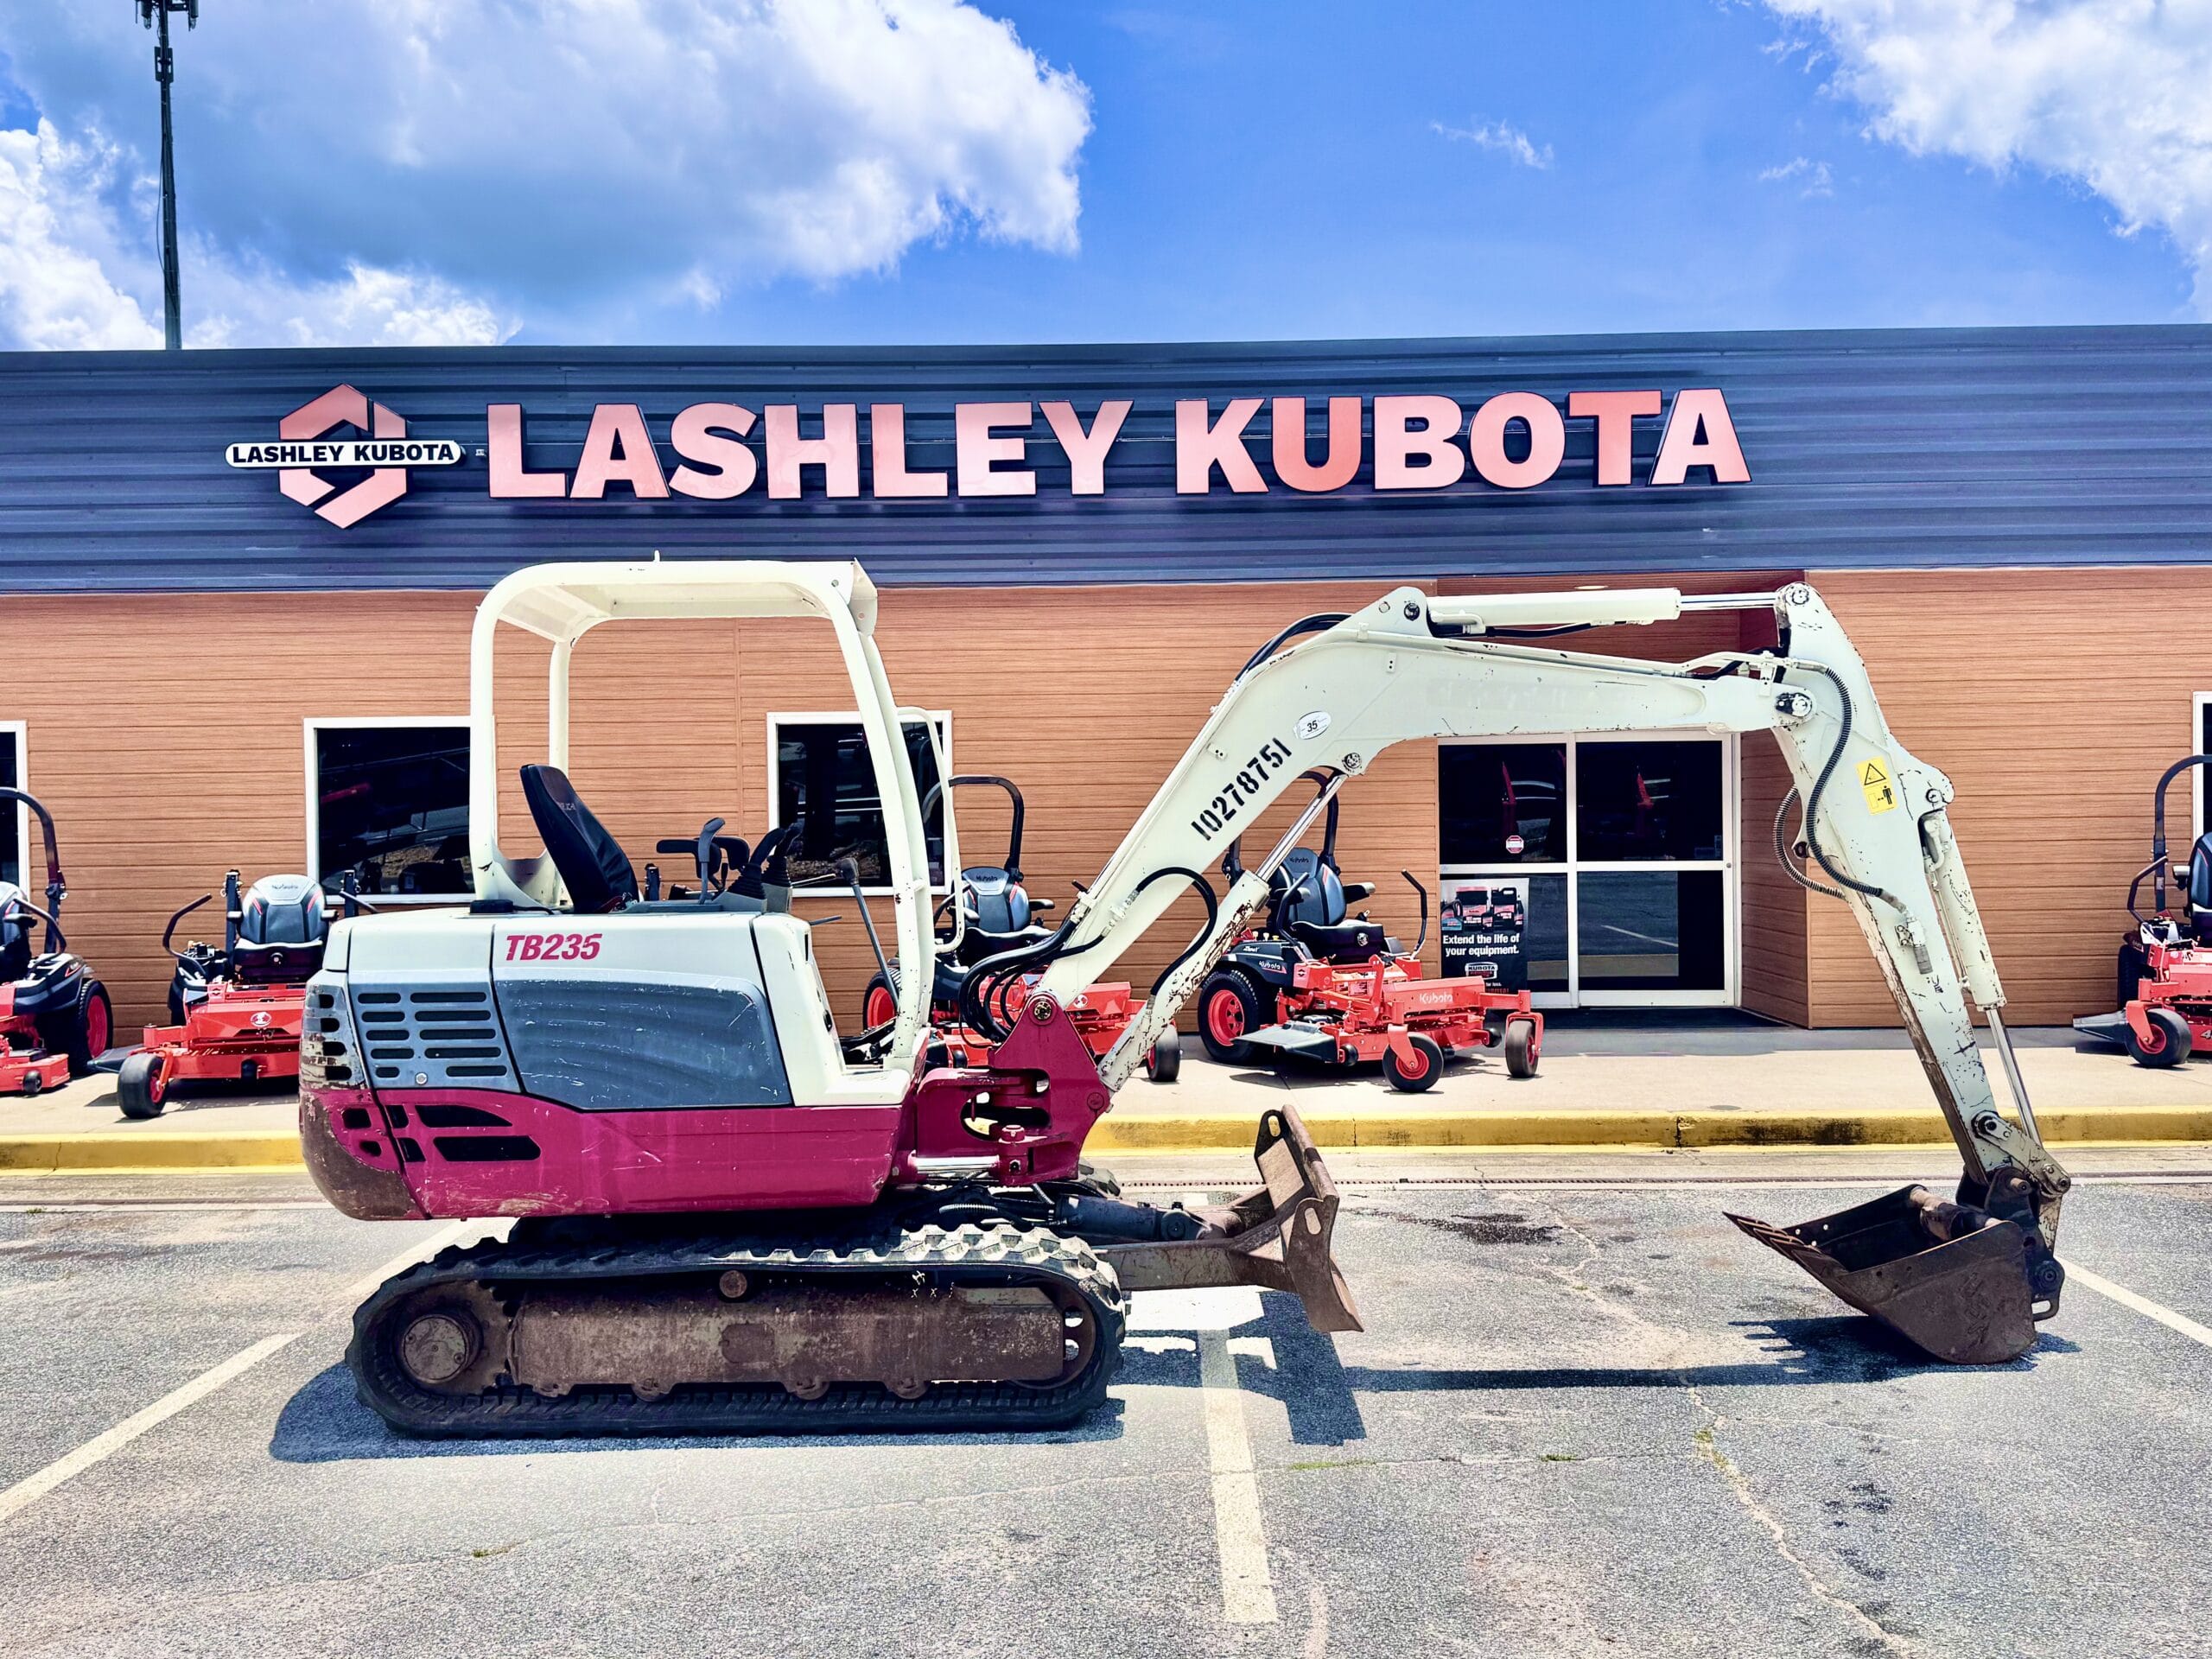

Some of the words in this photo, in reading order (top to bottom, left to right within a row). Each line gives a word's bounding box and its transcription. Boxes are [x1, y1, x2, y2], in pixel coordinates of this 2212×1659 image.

[487, 400, 1134, 500] LASHLEY
[1174, 388, 1752, 495] KUBOTA
[232, 445, 345, 463] LASHLEY
[354, 444, 454, 461] KUBOTA
[1306, 719, 1318, 733] 35
[1191, 737, 1293, 842] 10278751
[1443, 935, 1474, 944] Extend
[1477, 934, 1491, 944] the
[1494, 933, 1509, 944] life
[1510, 933, 1520, 943] of
[505, 933, 603, 961] TB235
[1446, 947, 1467, 957] your
[1469, 944, 1520, 957] equipment.
[1419, 992, 1453, 1003] Kubota
